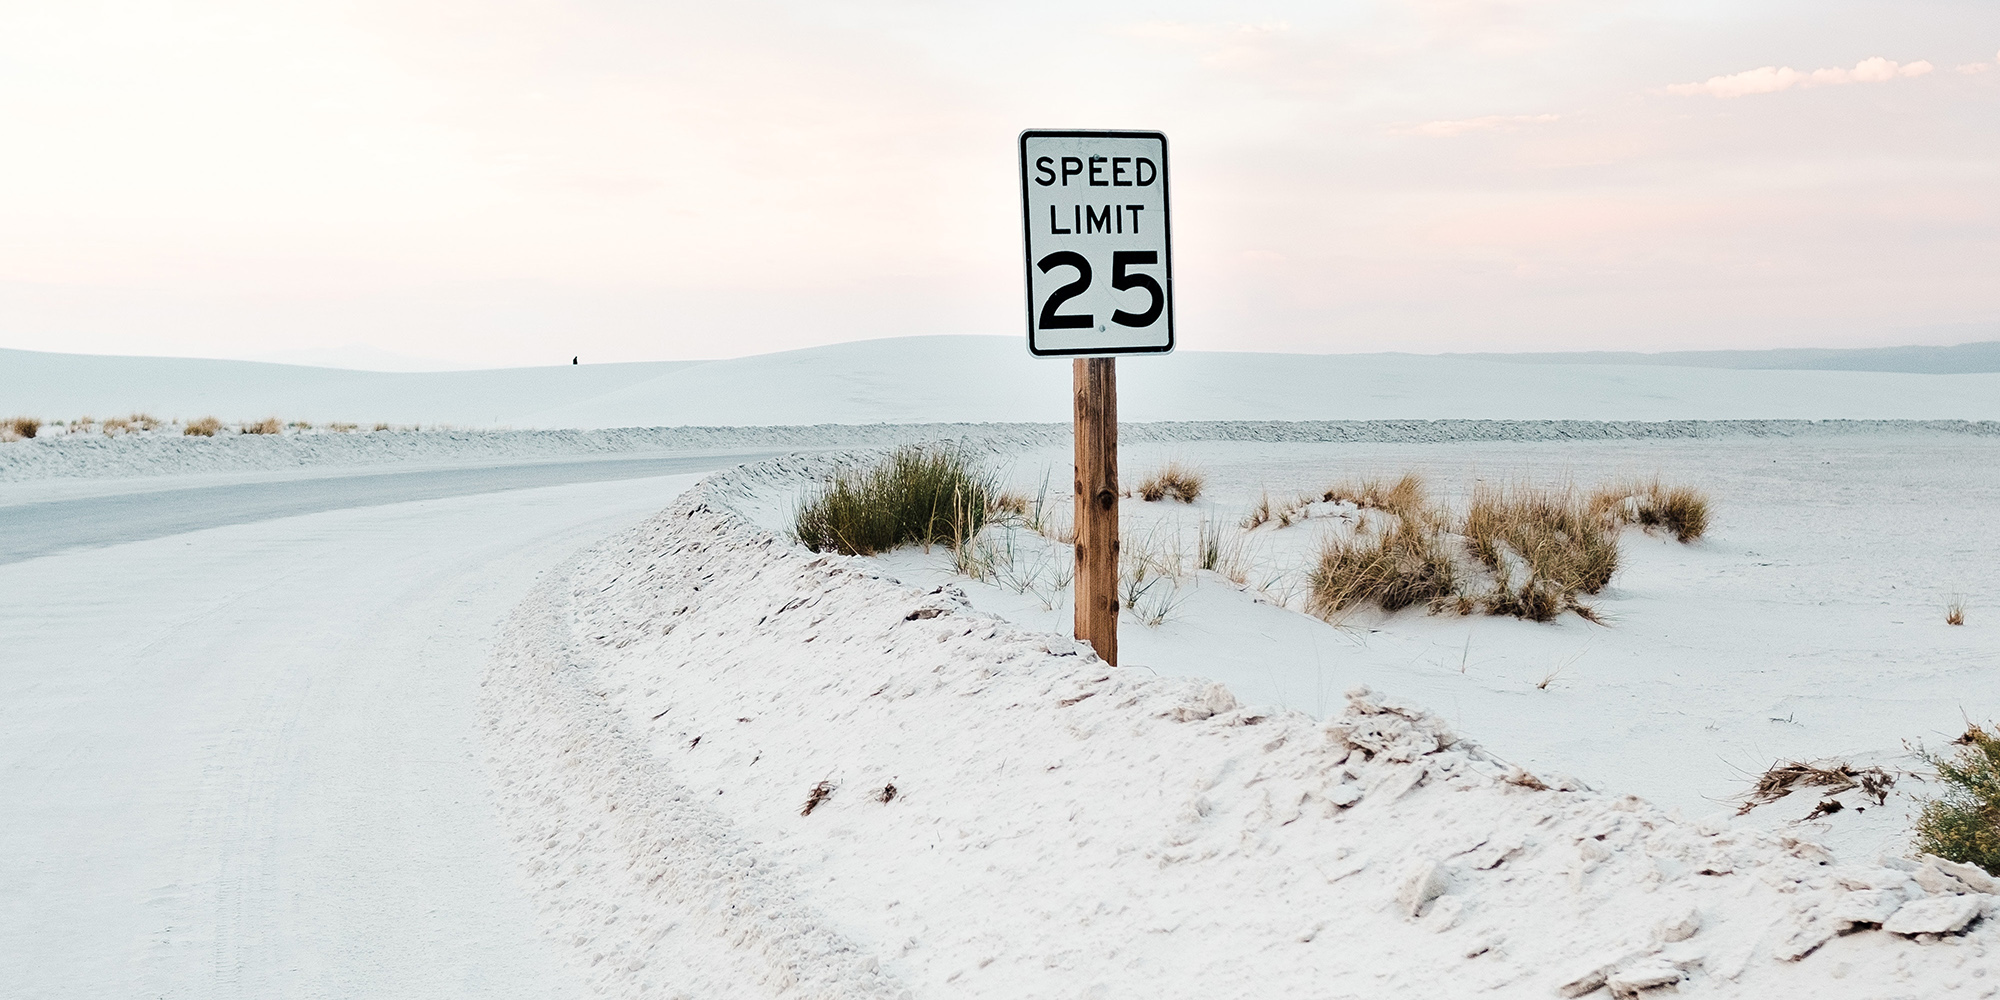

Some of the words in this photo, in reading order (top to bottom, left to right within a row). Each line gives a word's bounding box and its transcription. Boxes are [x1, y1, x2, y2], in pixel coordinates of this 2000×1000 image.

[1035, 156, 1157, 187] SPEED
[1050, 204, 1145, 234] LIMIT
[1037, 250, 1164, 330] 25
